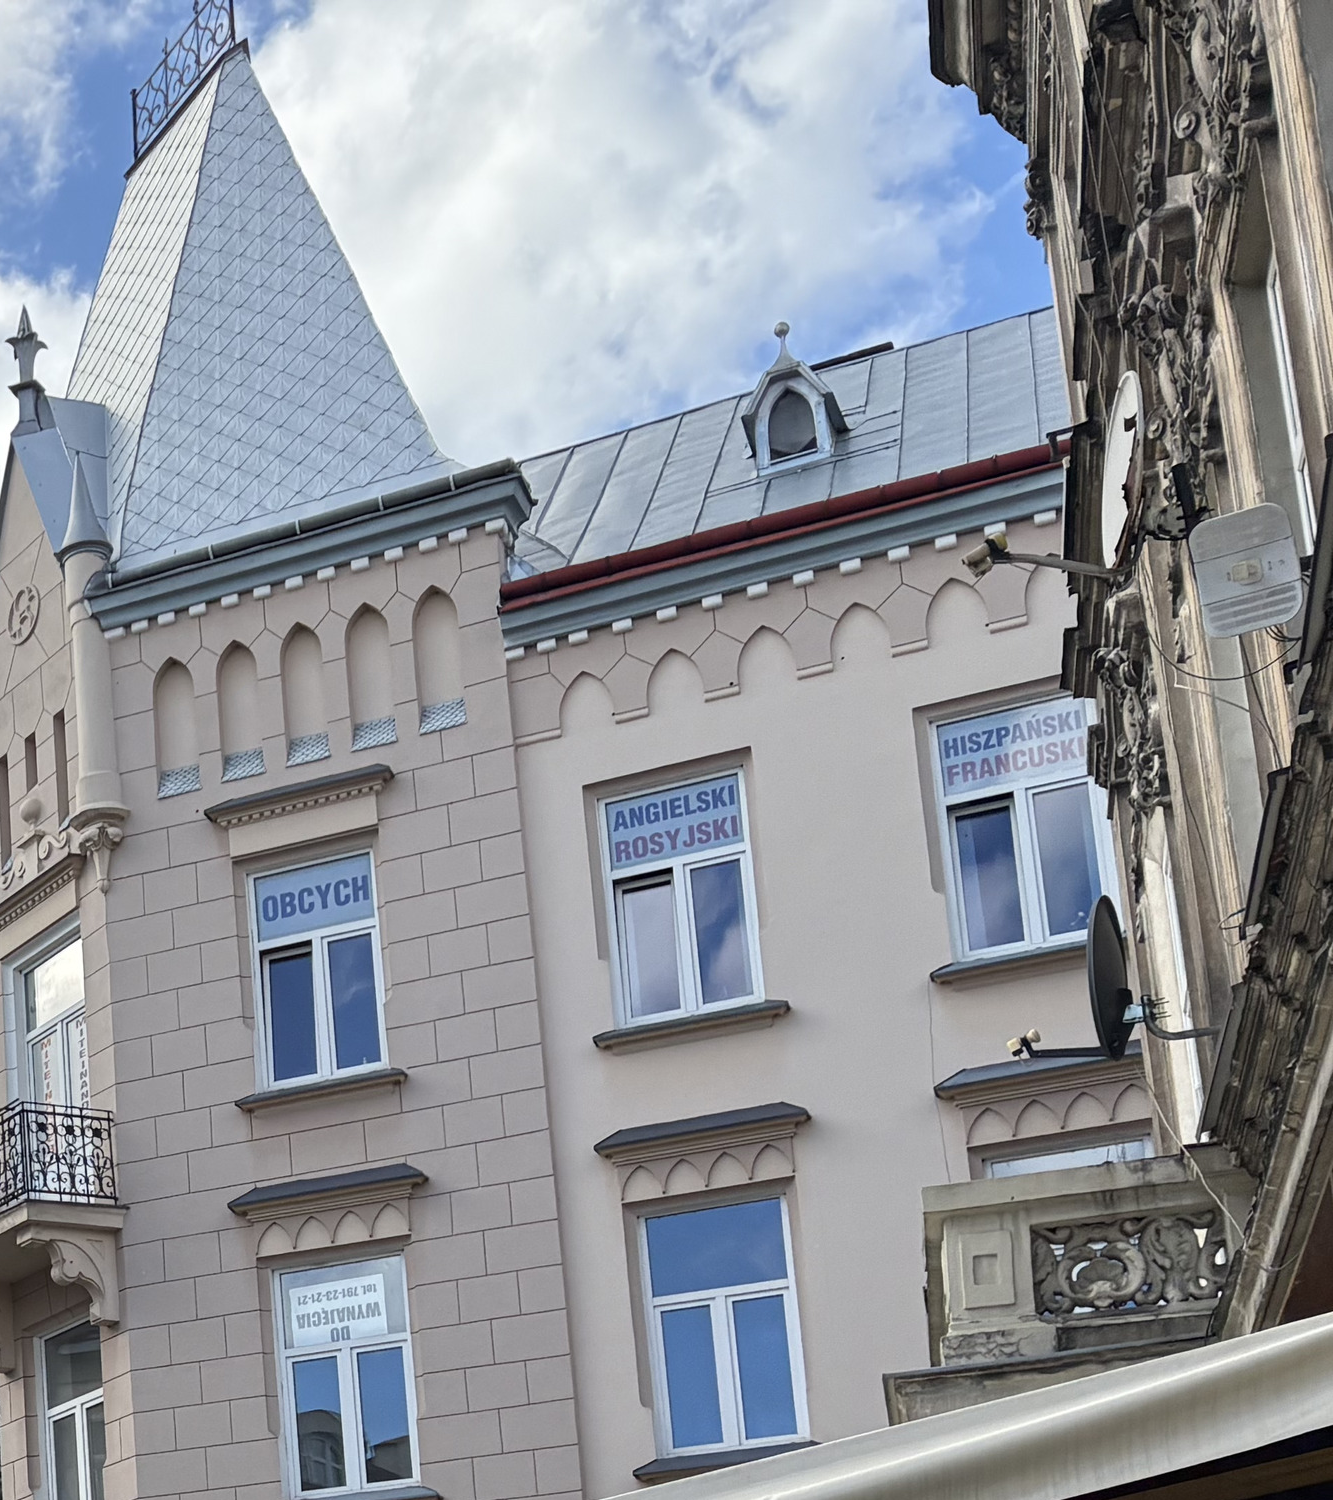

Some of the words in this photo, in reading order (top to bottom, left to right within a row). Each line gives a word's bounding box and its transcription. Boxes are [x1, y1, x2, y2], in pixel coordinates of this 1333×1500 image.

[943, 708, 1082, 759] HISZPAŃSKI
[946, 736, 1086, 787] FRANCUSKI
[613, 784, 736, 832] ANGIELSKI
[615, 814, 740, 863] ROSYJSKI
[262, 874, 370, 923] OBCYCH
[296, 1301, 382, 1329] WYNAJĘCIA
[330, 1325, 351, 1342] DO
